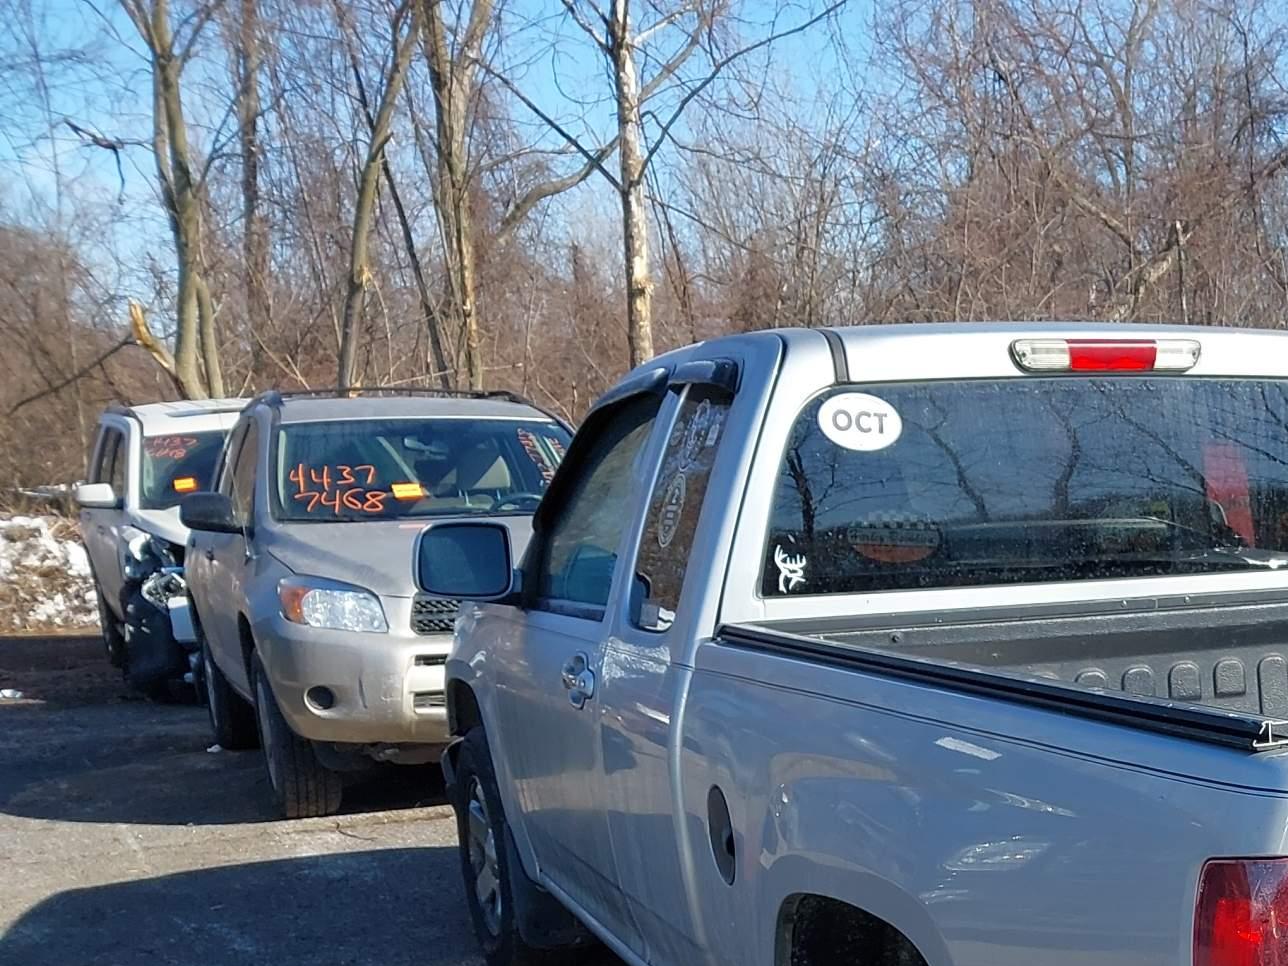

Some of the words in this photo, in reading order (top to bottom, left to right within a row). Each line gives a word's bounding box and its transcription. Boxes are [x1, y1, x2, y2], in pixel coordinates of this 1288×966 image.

[831, 408, 888, 434] OCT
[289, 463, 376, 492] 4437
[294, 487, 389, 514] 7468
